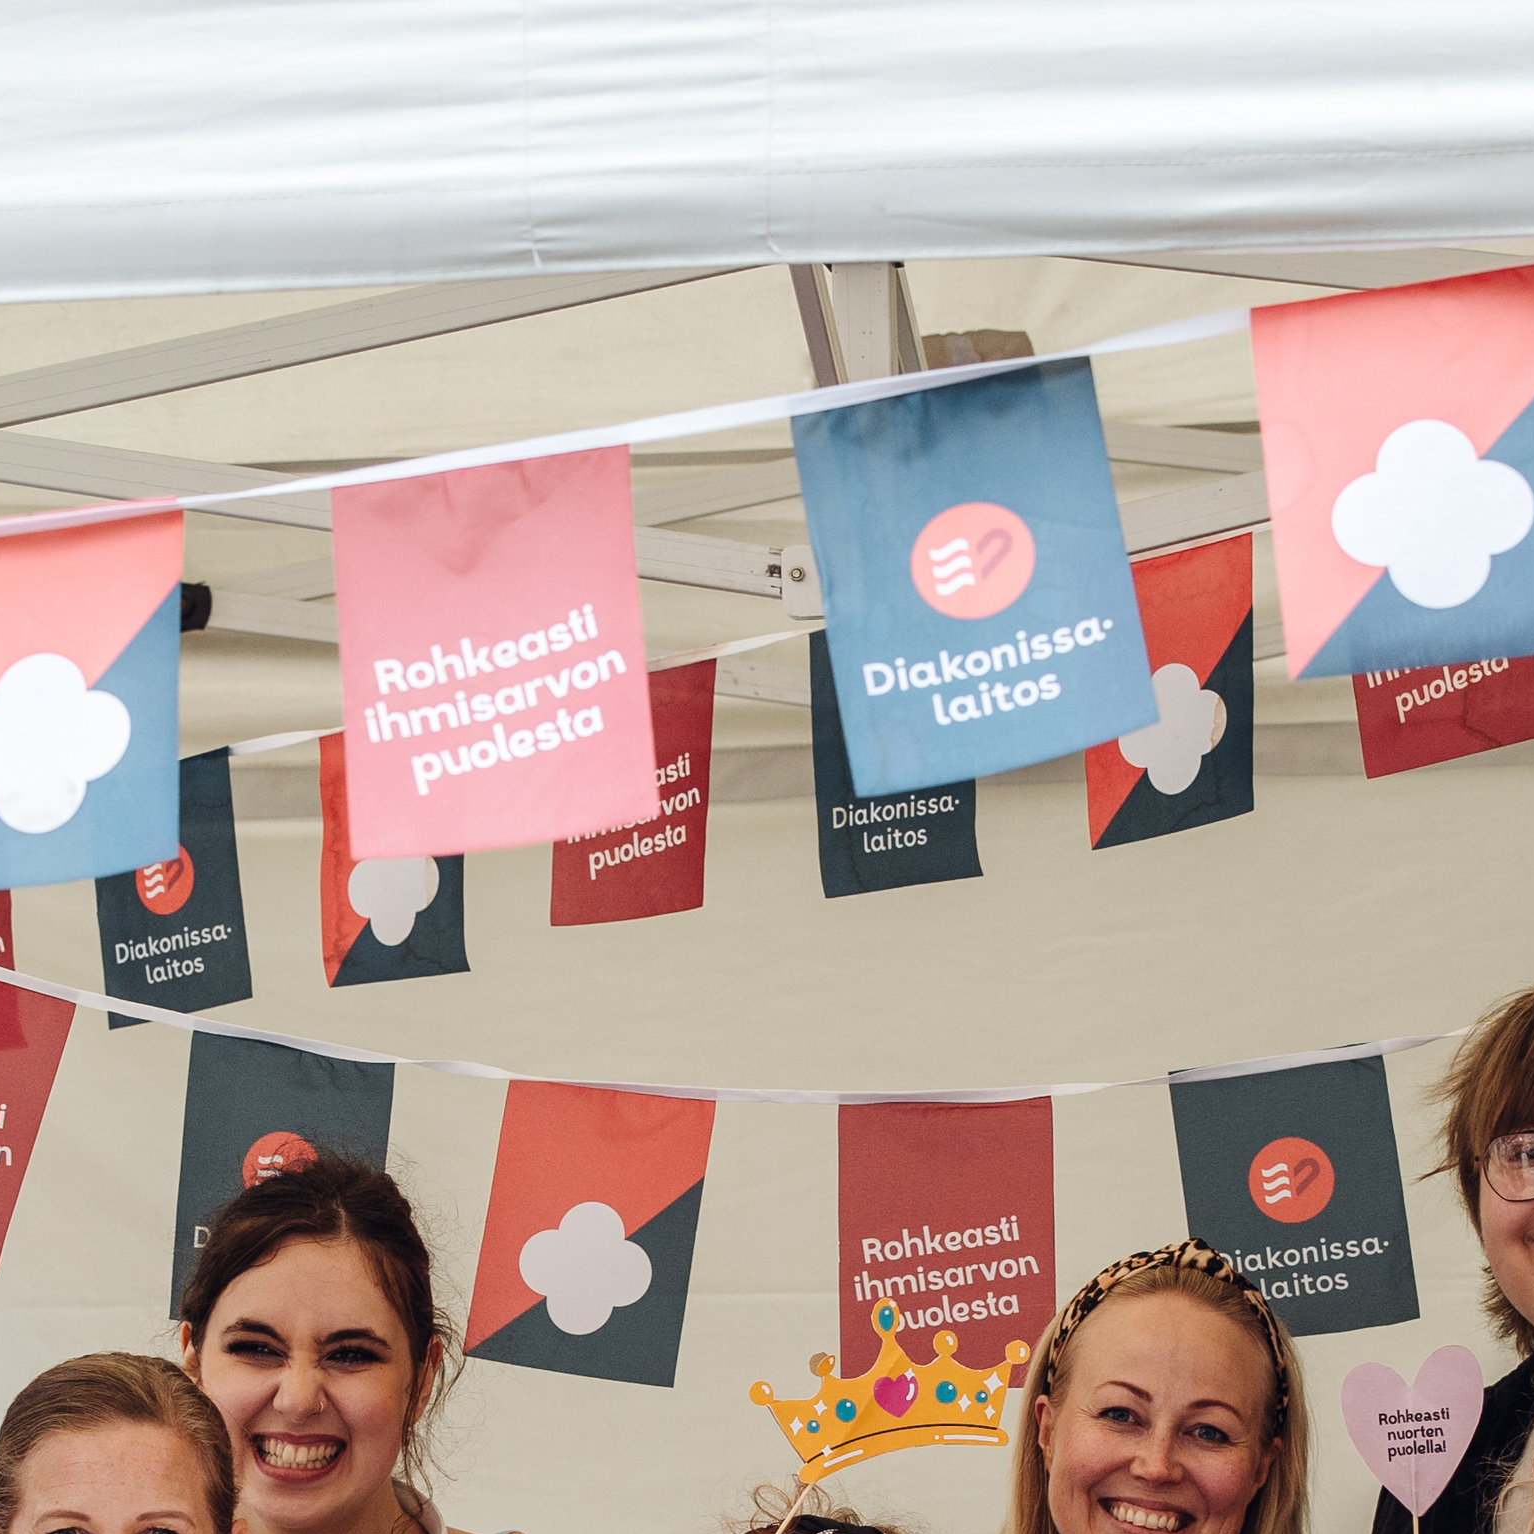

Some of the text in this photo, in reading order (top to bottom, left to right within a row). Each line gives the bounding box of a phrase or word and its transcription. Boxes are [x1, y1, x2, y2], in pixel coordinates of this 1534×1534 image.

[374, 604, 598, 695] Rohkeasti
[364, 649, 628, 743] ihmisarvon
[931, 672, 1062, 727] laitos
[1395, 657, 1509, 724] puolesta
[411, 701, 604, 797] puolesta
[588, 824, 687, 881] puolesta
[863, 825, 927, 853] laitos
[145, 953, 205, 985] laitos
[861, 1215, 1020, 1264] Rohkeasti
[853, 1254, 1040, 1302] ihmisarvon
[1260, 1272, 1350, 1301] laitos
[1377, 1407, 1450, 1428] Rohkeasti
[1386, 1424, 1445, 1442] nuorten
[1386, 1437, 1447, 1459] puolella!
